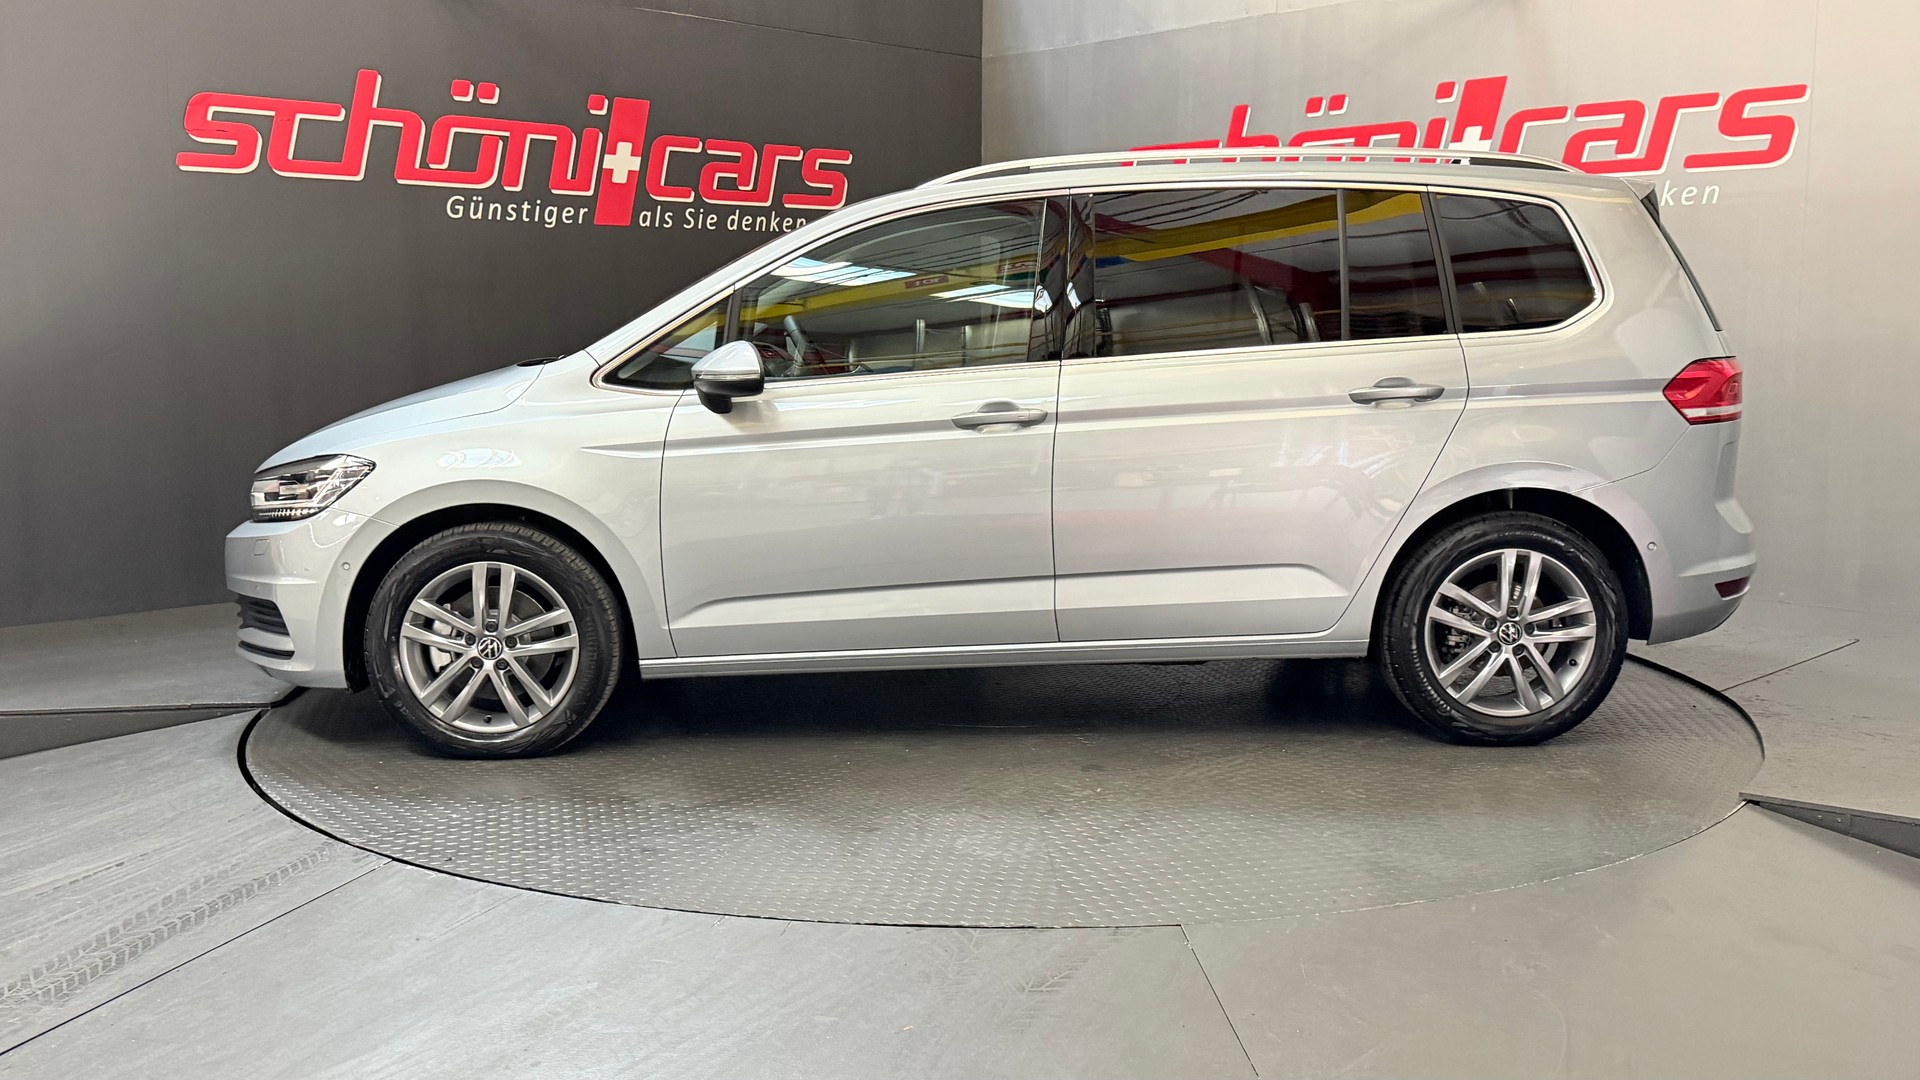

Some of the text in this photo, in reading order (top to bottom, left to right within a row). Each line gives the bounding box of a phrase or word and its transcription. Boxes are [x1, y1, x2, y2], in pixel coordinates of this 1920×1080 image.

[1660, 180, 1720, 207] ken
[446, 195, 589, 229] Günstiger
[638, 205, 674, 228] als
[683, 207, 718, 230] Sie
